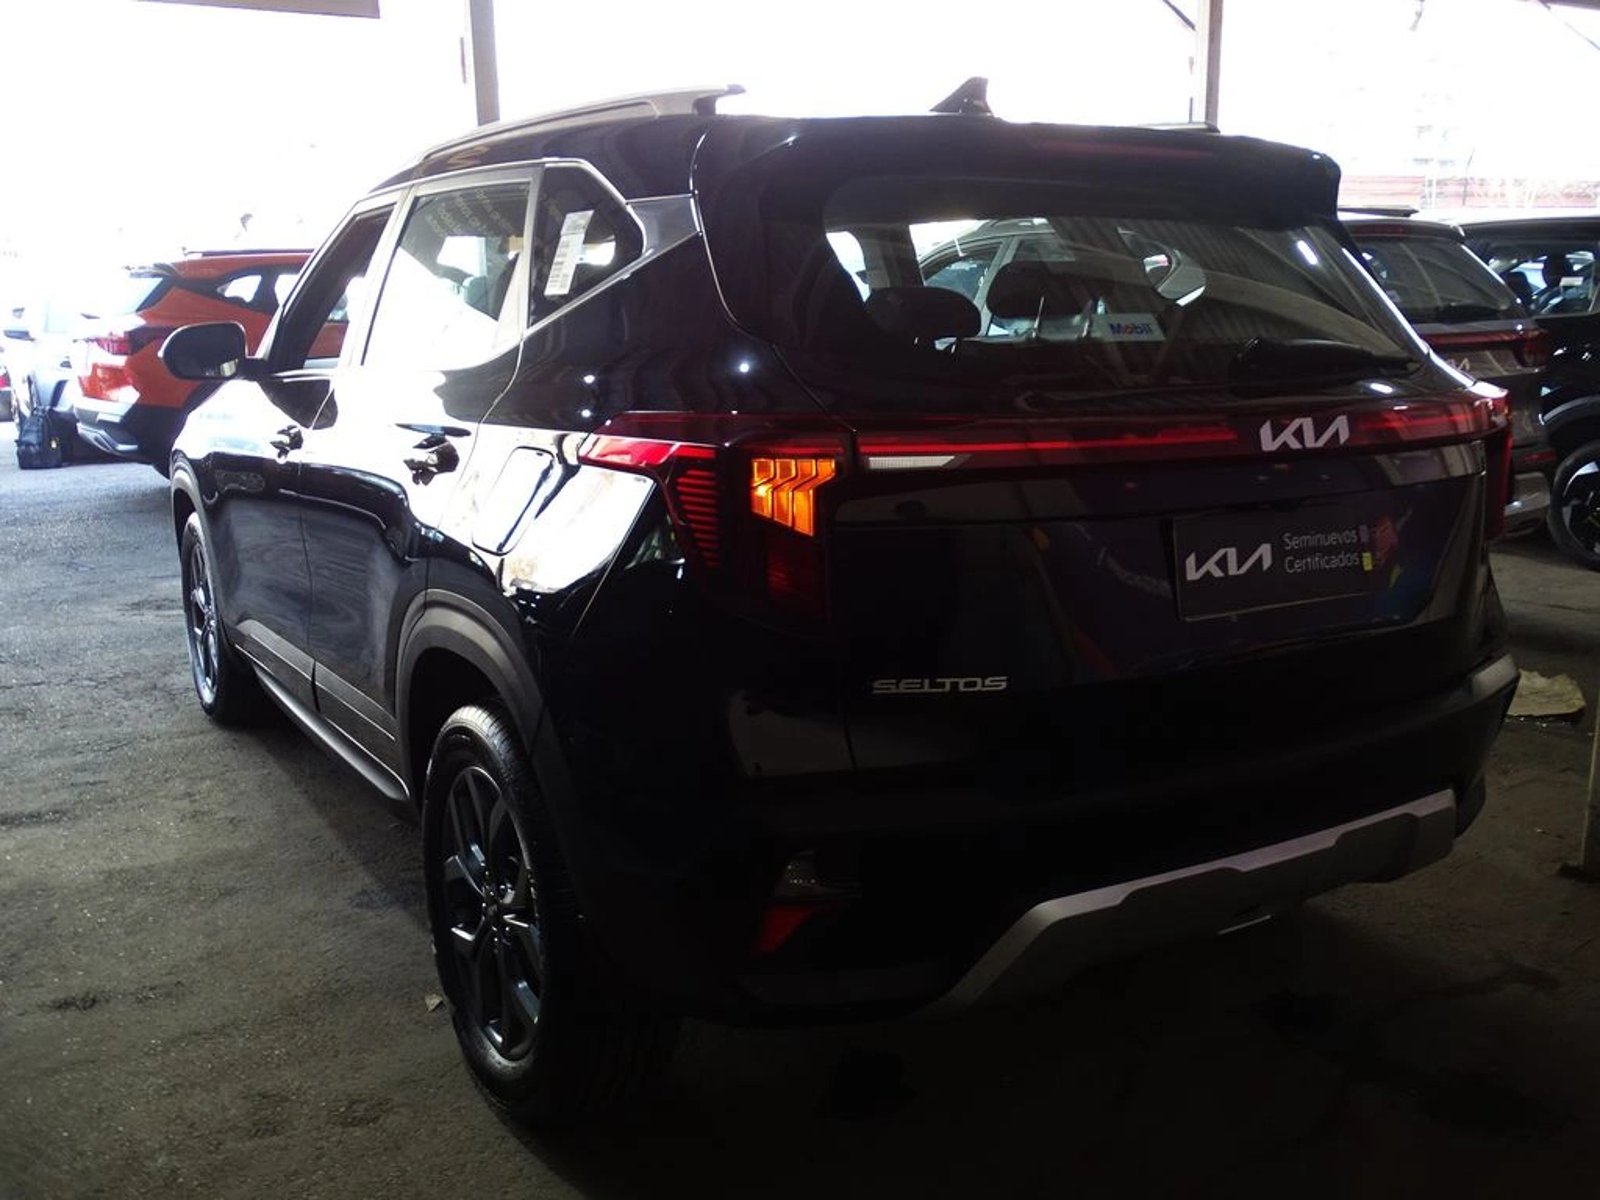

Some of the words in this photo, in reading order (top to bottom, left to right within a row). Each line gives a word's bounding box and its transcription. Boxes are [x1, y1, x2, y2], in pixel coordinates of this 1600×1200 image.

[1260, 415, 1350, 452] KIA
[1283, 530, 1358, 550] Seminuevos
[1185, 543, 1272, 582] KIA
[1284, 551, 1360, 573] Certificados
[872, 676, 1008, 693] SELTOS
